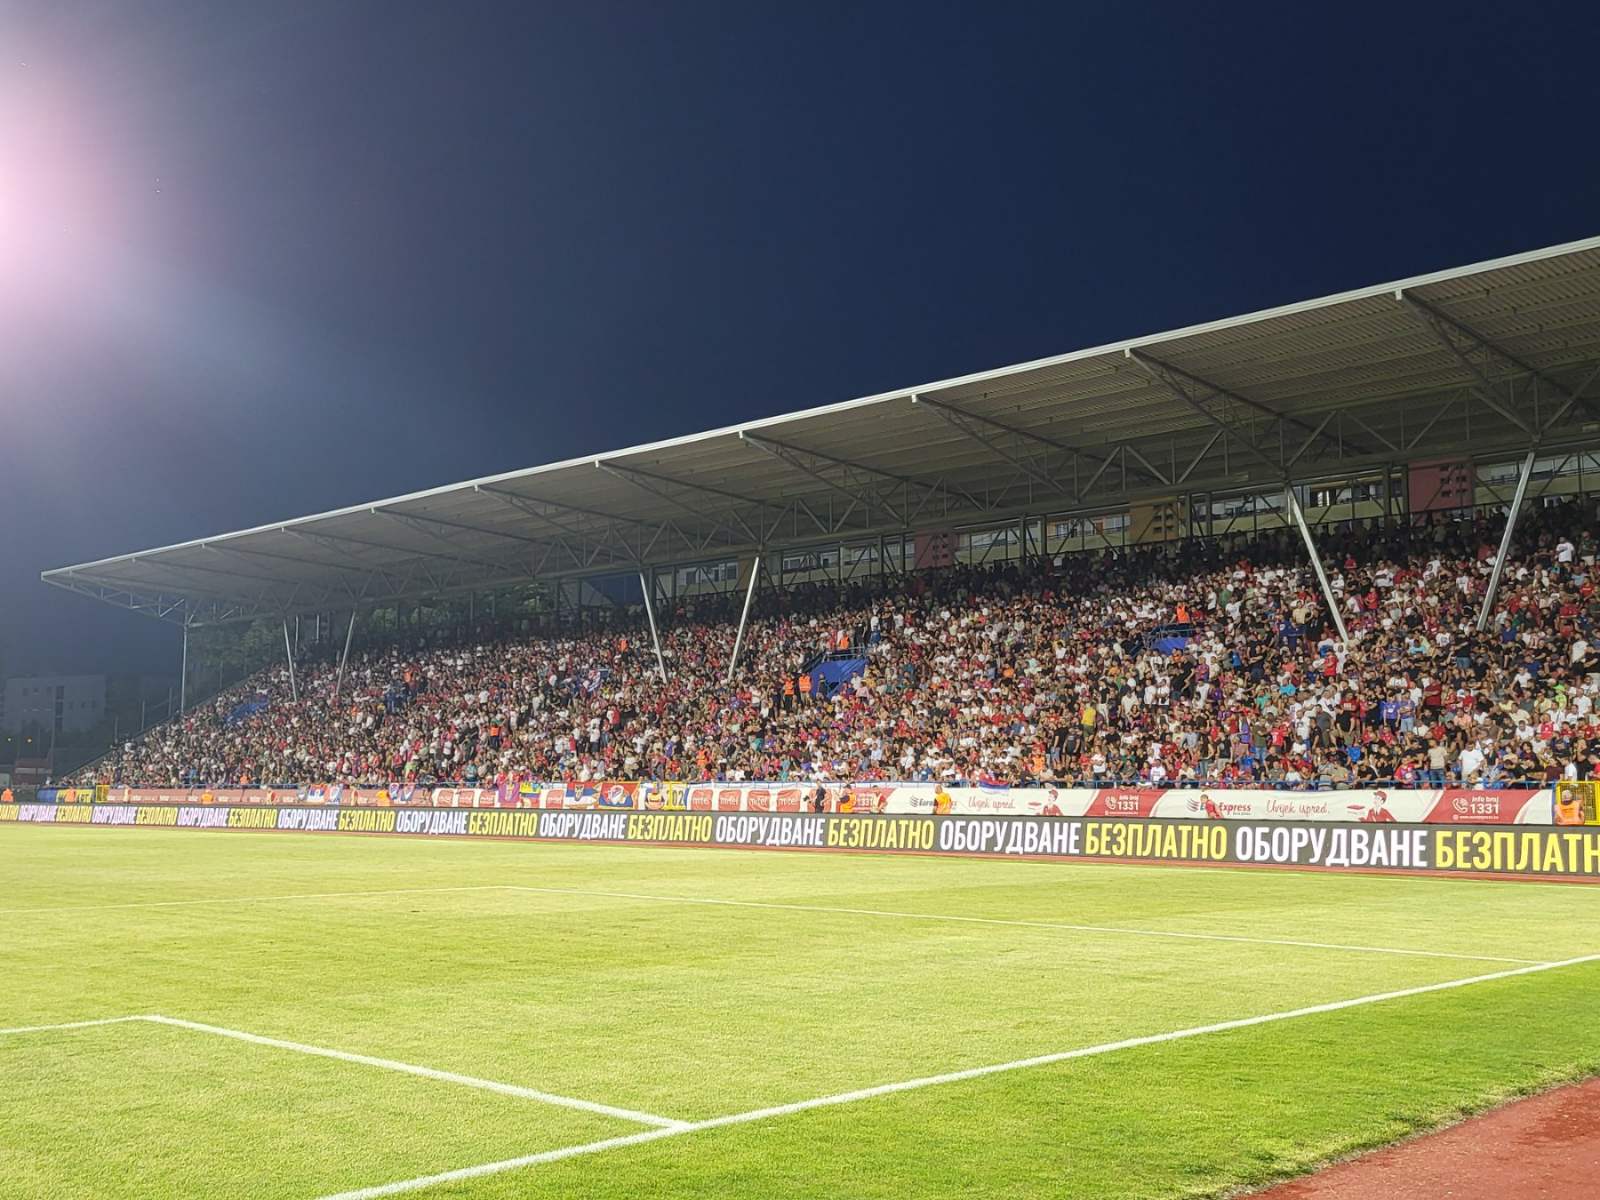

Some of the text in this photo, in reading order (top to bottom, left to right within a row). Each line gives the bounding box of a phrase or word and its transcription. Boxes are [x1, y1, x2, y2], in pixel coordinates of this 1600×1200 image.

[1117, 801, 1139, 811] 1331
[1470, 803, 1499, 815] 1331
[278, 809, 338, 831] ОБОРУДВАНЕ
[339, 810, 394, 832] БЕЗПЛАТНО
[396, 811, 467, 834] ОБОРУДВАНЕ
[469, 812, 537, 836] БЕЗПЛАТНО
[540, 814, 626, 839] ОБОРУДВАНЕ
[628, 815, 712, 841] БЕЗПЛАТНО
[715, 816, 825, 846] ОБОРУДВАНЕ
[828, 818, 934, 849] БЕЗПЛАТНО
[940, 820, 1081, 854] ОБОРУДВАНЕ
[1085, 823, 1227, 859] БЕЗПЛАТНО
[1236, 826, 1427, 866] ОБОРУДВАНЕ
[1436, 830, 1600, 873] БЕЗПЛАТН
